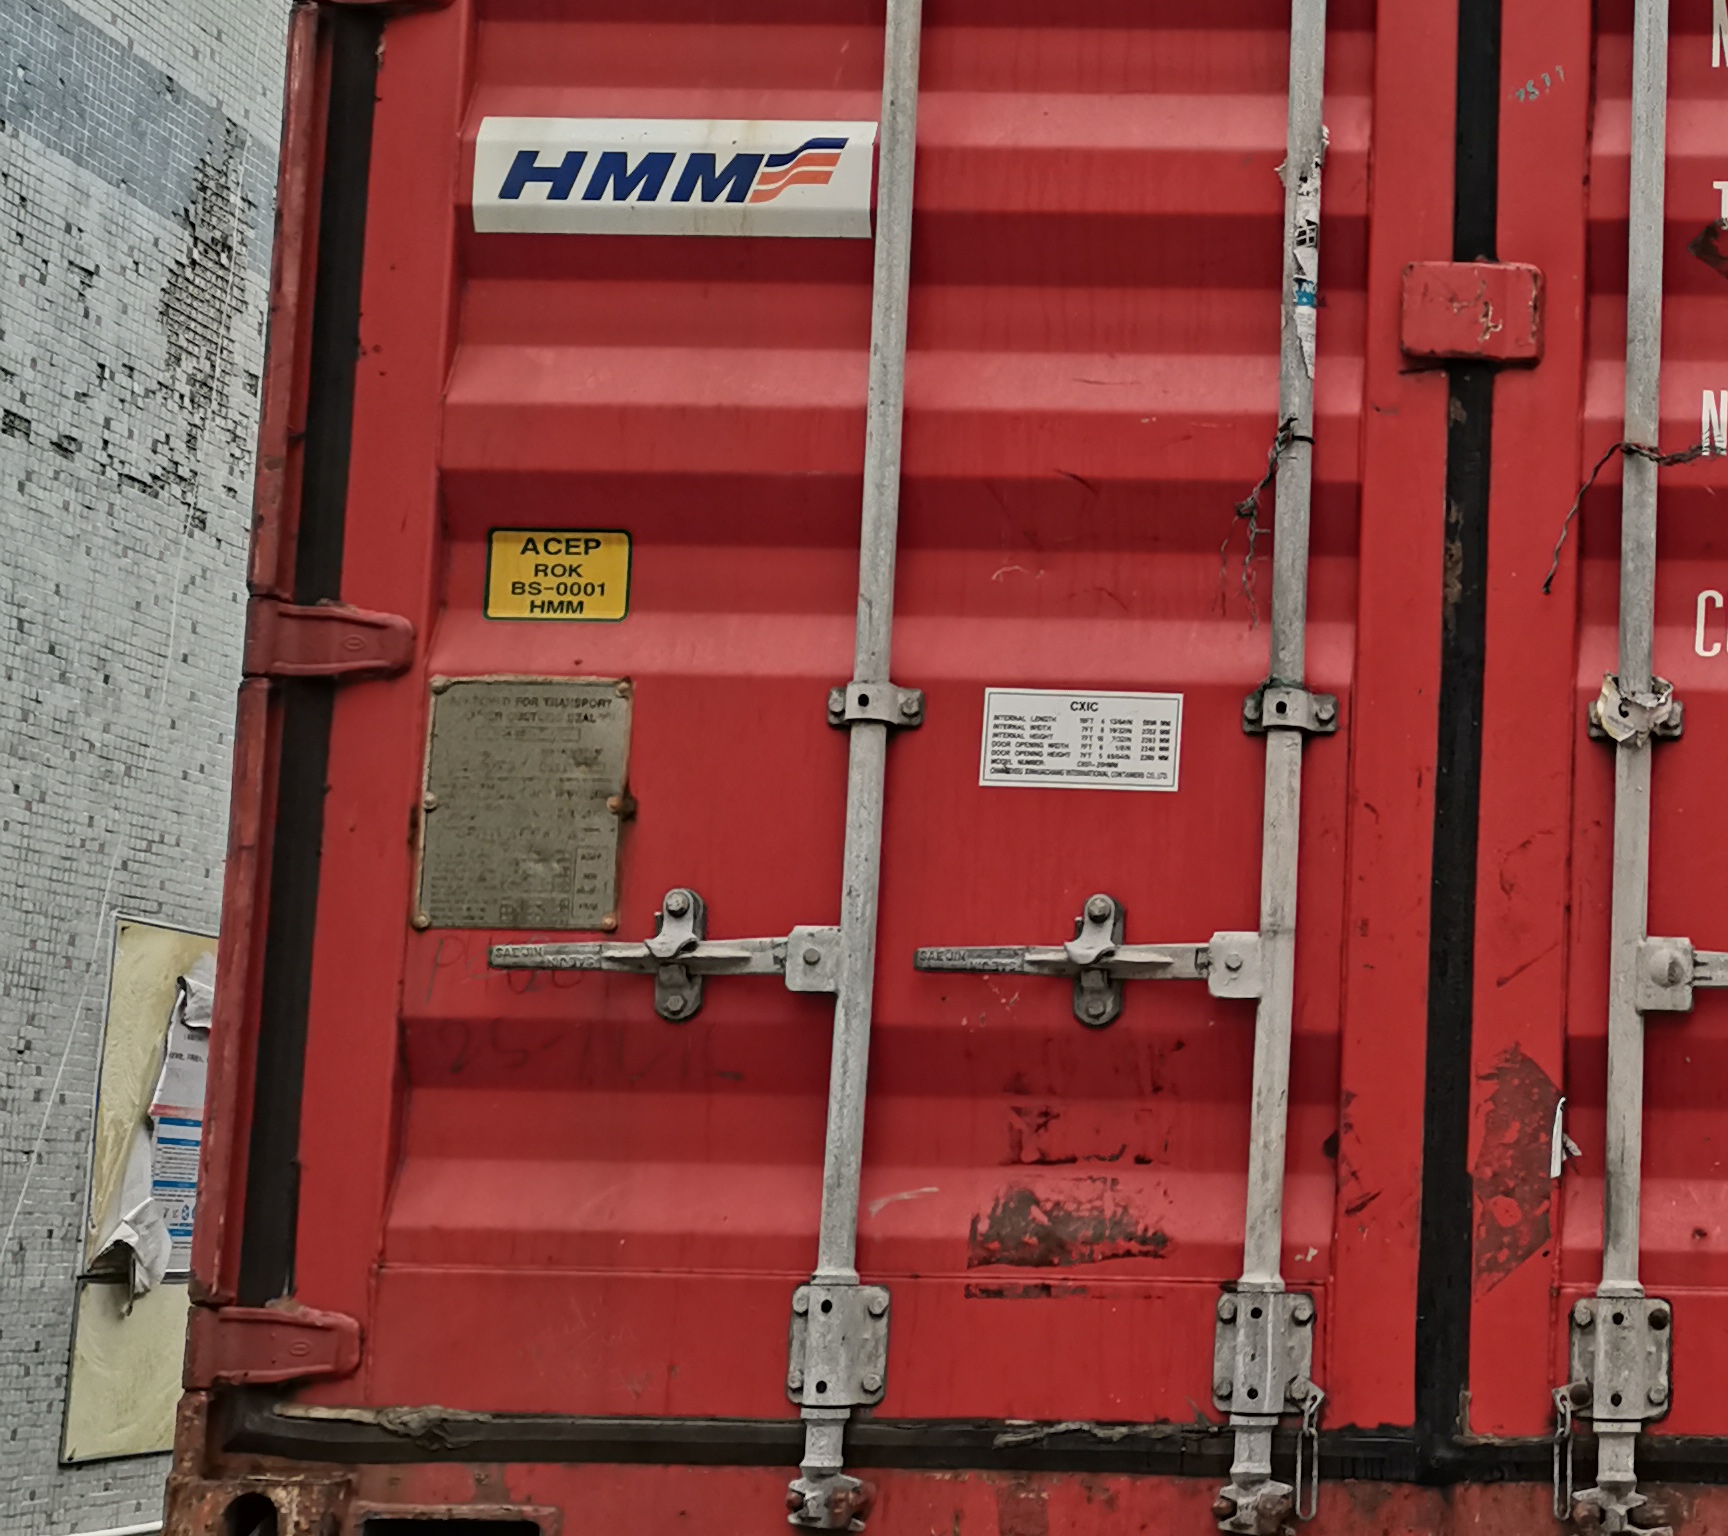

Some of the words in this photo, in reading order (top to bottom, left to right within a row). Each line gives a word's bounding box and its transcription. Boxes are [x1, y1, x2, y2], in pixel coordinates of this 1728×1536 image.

[498, 150, 766, 203] HMM
[520, 537, 602, 556] ACEP
[533, 563, 584, 578] ROK
[511, 581, 606, 597] BS-0001
[529, 600, 584, 615] HMM
[1070, 701, 1099, 712] CXIC
